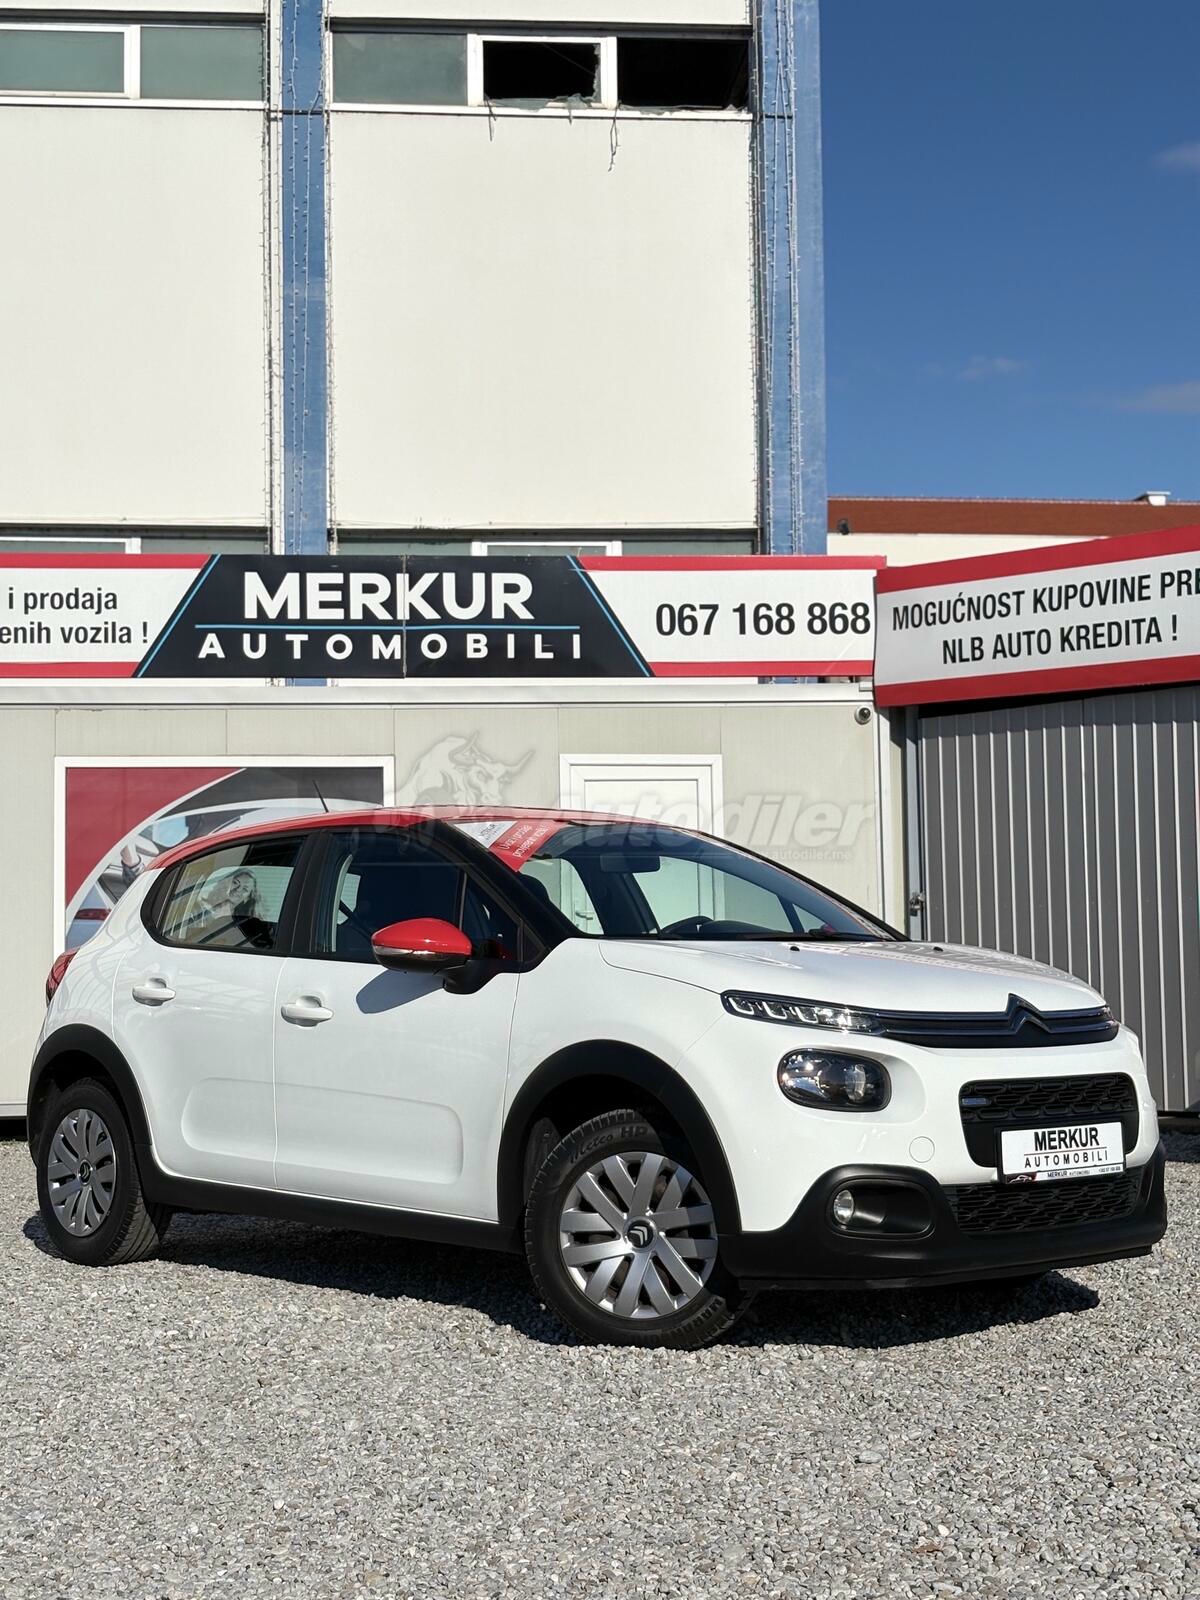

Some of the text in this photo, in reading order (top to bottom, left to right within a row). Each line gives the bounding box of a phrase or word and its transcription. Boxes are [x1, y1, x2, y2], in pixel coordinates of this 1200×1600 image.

[8, 586, 118, 615] i prodaja
[243, 571, 534, 621] MERKUR
[892, 590, 1025, 631] MOGUĆNOST
[1032, 574, 1151, 614] KUPOVINE
[60, 621, 132, 644] vozila
[142, 621, 148, 644] !
[655, 601, 871, 636] 067 168 868
[198, 633, 581, 660] AUTOMOBILI
[942, 636, 984, 665] NLB
[992, 628, 1050, 660] AUTO
[1059, 616, 1162, 653] KREDITA
[1033, 1127, 1100, 1152] MERKUR
[1024, 1149, 1108, 1169] AUTOMOBILI
